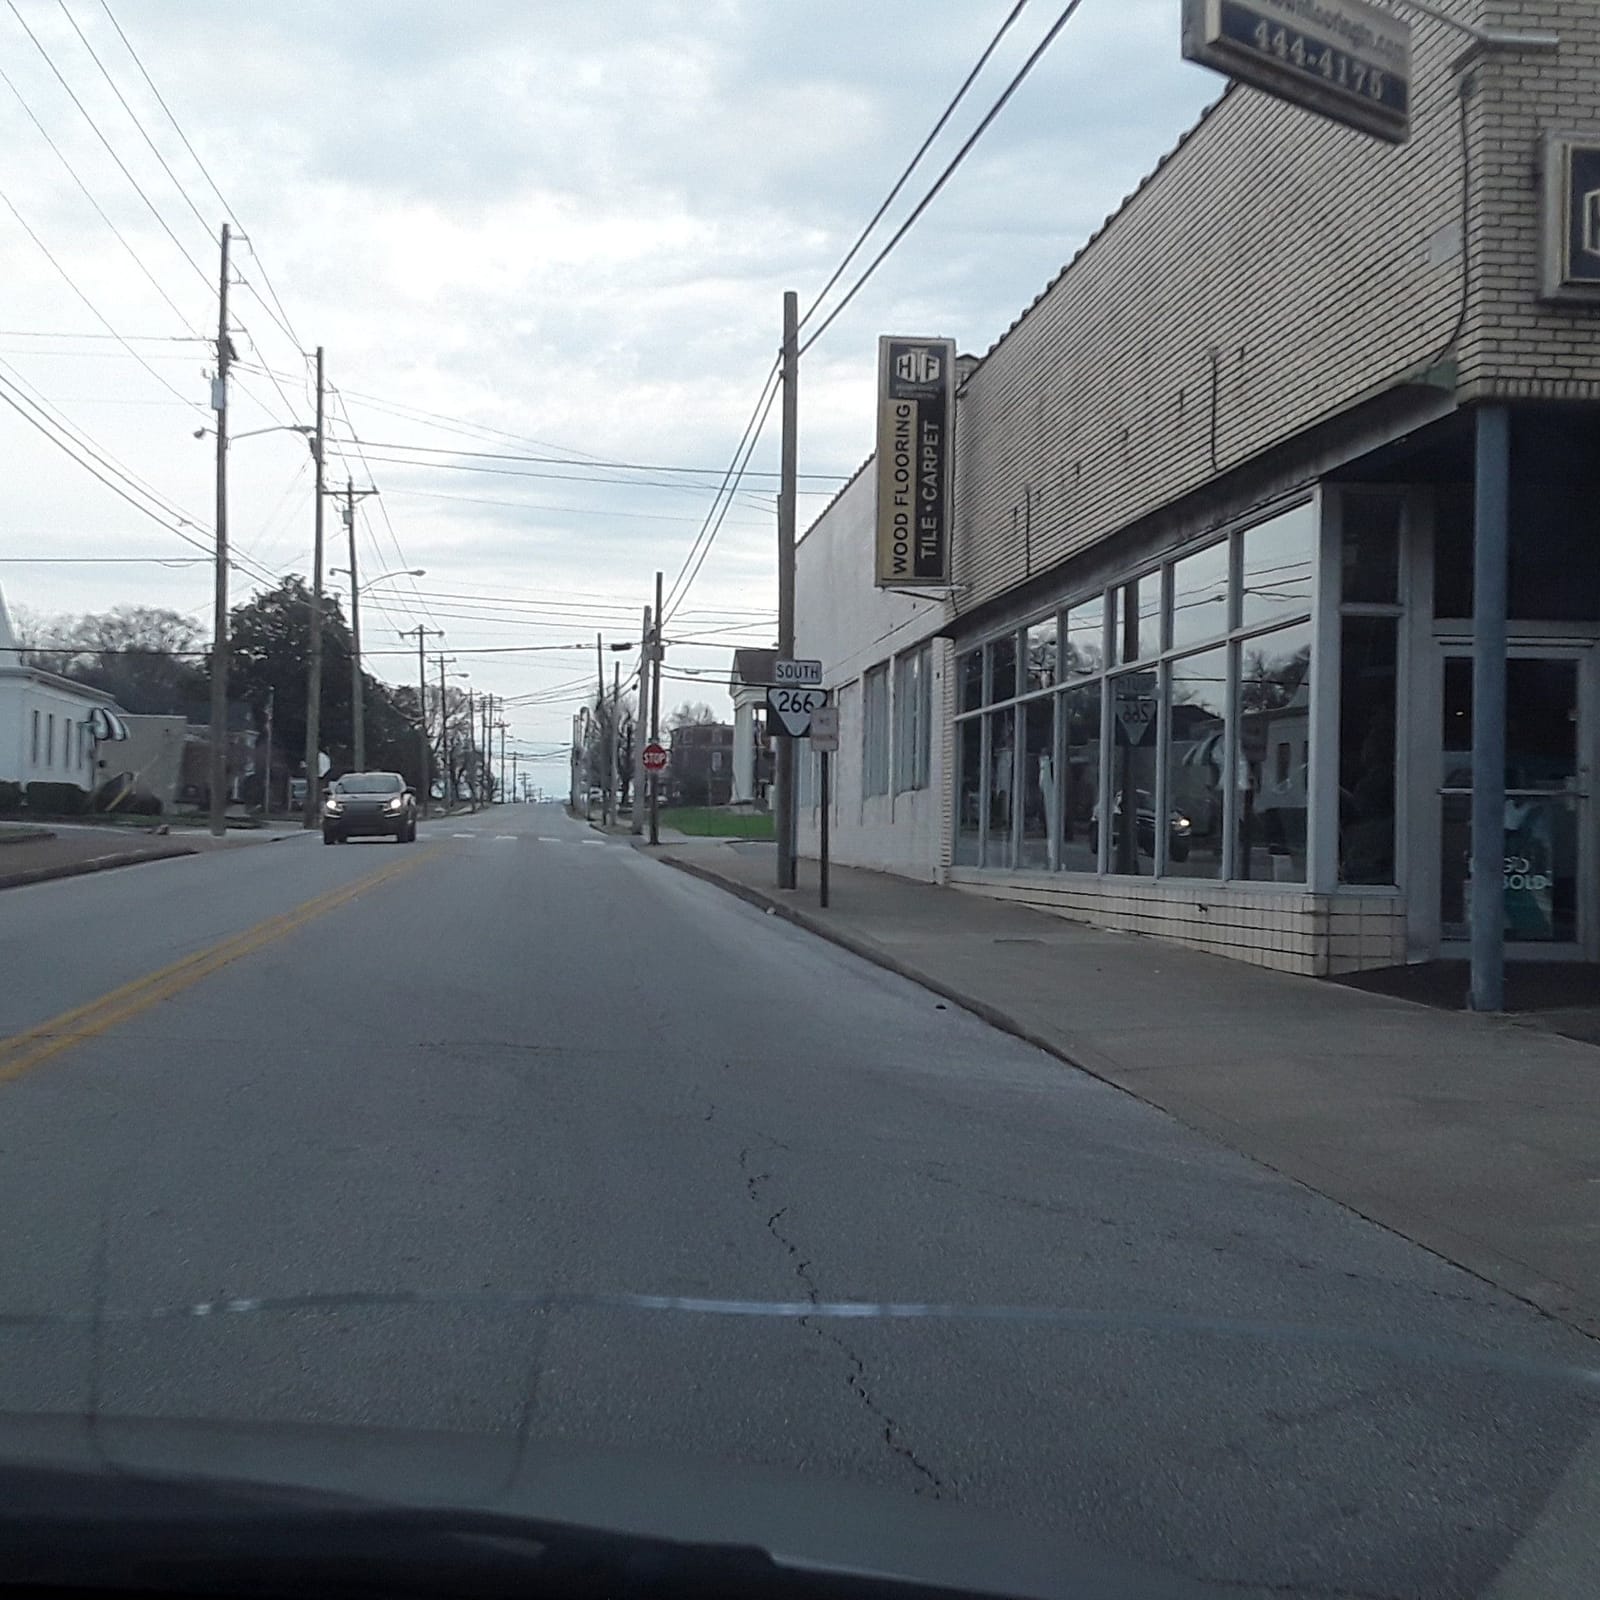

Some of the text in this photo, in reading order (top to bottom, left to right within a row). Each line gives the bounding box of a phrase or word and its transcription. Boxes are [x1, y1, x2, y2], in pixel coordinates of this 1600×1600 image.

[893, 404, 911, 575] WOOD FLOORING
[921, 420, 939, 559] TILE CARPET
[776, 664, 819, 679] SOUTH
[778, 690, 815, 714] 266
[643, 752, 666, 764] STOP
